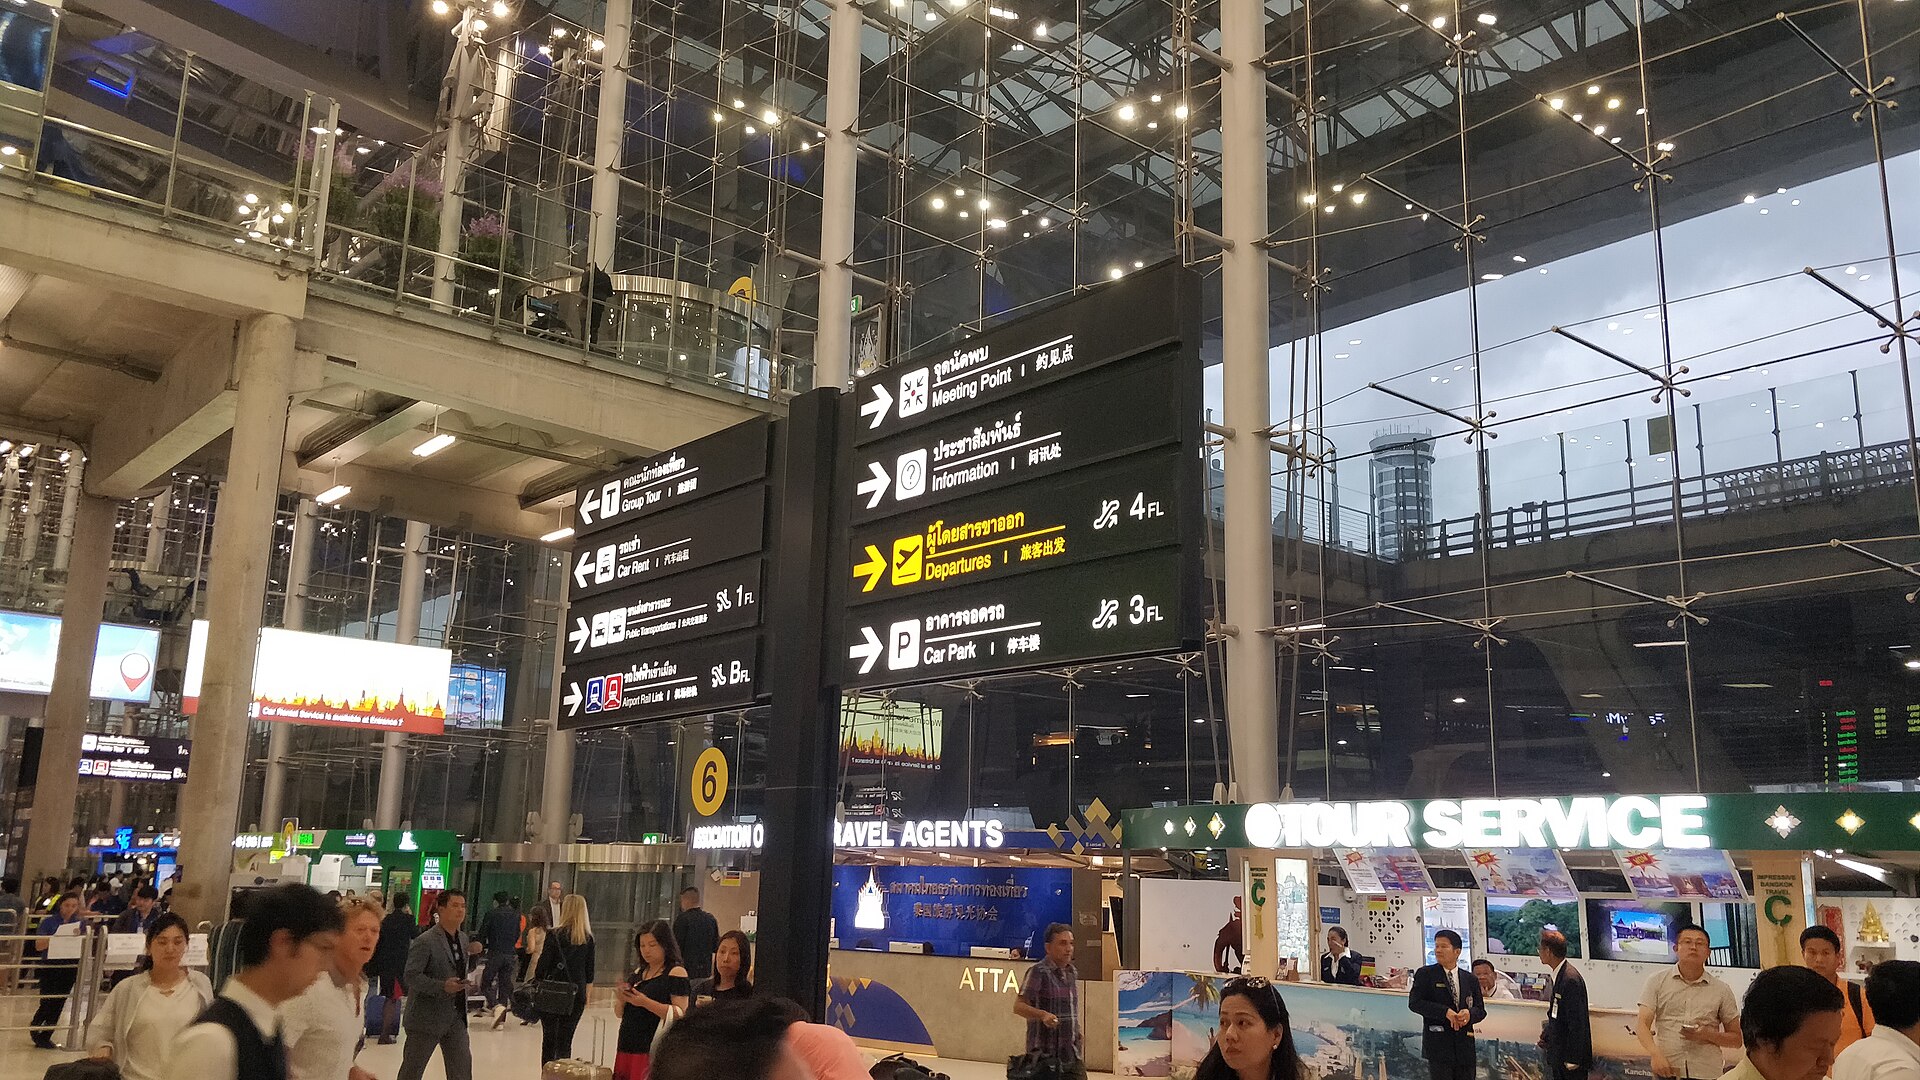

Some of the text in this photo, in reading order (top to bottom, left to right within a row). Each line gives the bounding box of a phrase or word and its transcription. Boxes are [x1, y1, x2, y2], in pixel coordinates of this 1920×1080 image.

[933, 345, 989, 384] จุดนัดพบ
[1036, 343, 1074, 372] 约见点
[932, 366, 1012, 408] Meeting Point
[933, 410, 1022, 462] ประชาสัมพันธ์
[1028, 442, 1062, 466] 问讯处
[932, 460, 999, 492] Information
[622, 489, 662, 512] Group Tour
[926, 511, 1026, 555] ผู้โดยสารขาออก
[1020, 536, 1066, 562] 旅客出发
[617, 558, 651, 578] Car Rent
[925, 553, 992, 581] Departures
[925, 603, 1005, 632] อาคารจอดรถ
[625, 628, 641, 640] Public
[923, 640, 977, 665] Car Park
[622, 696, 640, 708] Airport
[640, 692, 651, 704] Rail
[651, 691, 664, 703] Link
[701, 761, 718, 803] 6
[900, 819, 1004, 848] AGENTS
[1422, 796, 1711, 849] SERVICE
[424, 859, 440, 868] ATM
[959, 967, 1020, 993] ATTA
